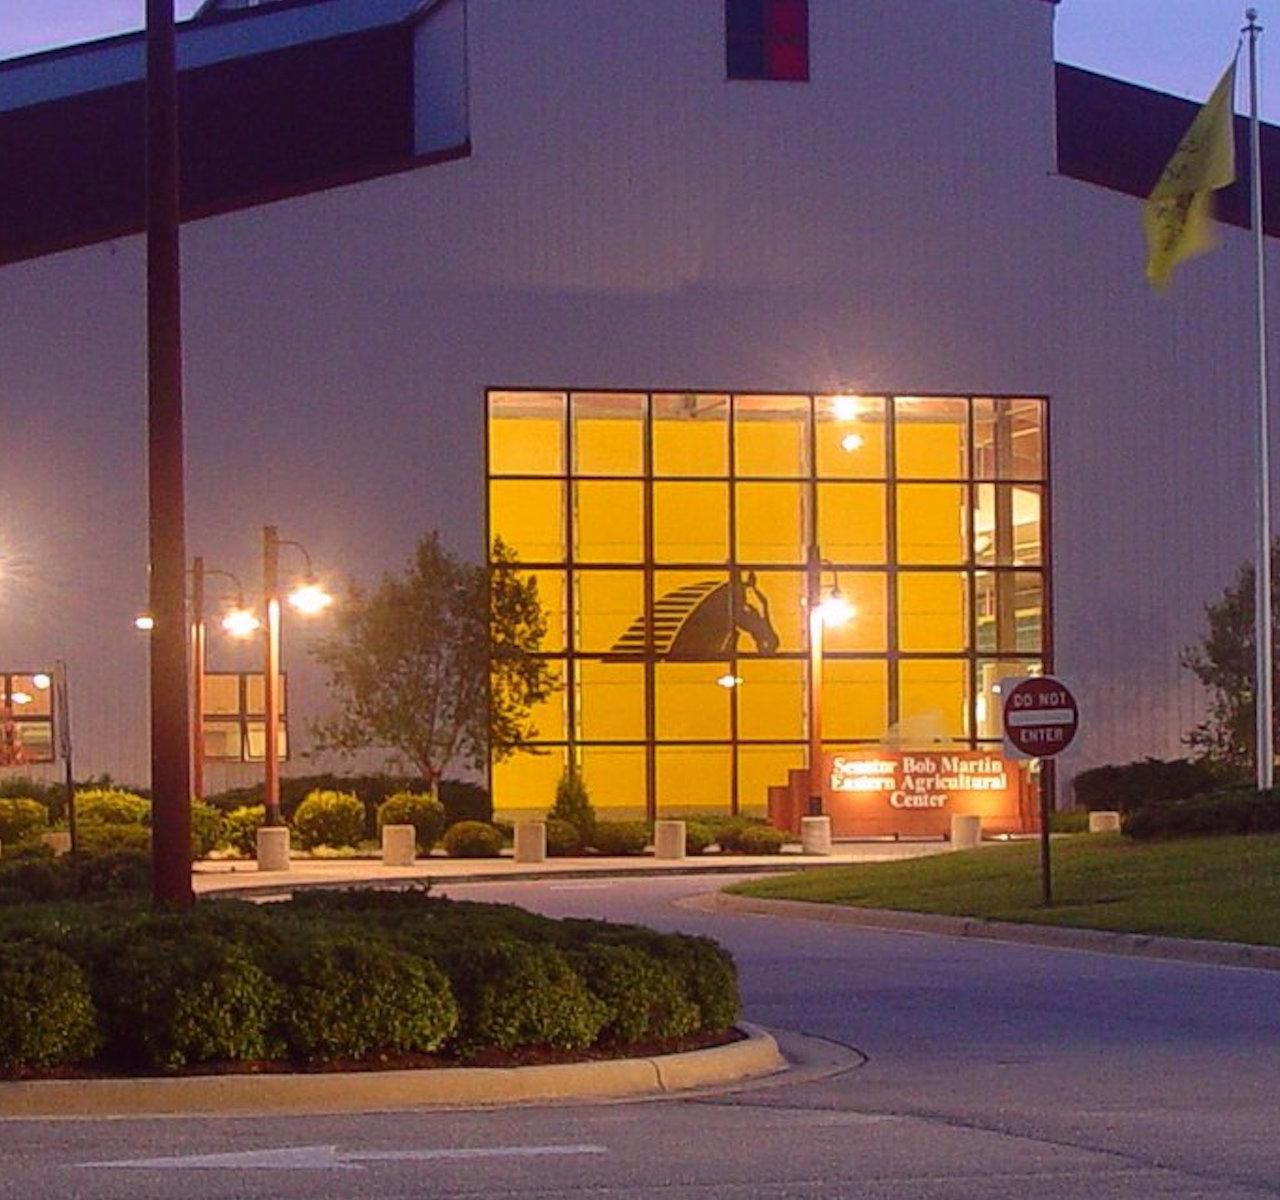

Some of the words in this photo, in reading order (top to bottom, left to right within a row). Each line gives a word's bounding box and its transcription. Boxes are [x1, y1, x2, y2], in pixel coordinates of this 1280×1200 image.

[1013, 692, 1033, 707] DO
[1039, 691, 1067, 706] NOT
[1021, 728, 1063, 743] ENTER
[833, 756, 898, 774] Senator
[902, 756, 937, 774] Bob
[940, 756, 1003, 774] Martin
[831, 774, 896, 791] Eastern
[901, 773, 1008, 793] Agricultural
[890, 791, 948, 808] Center
